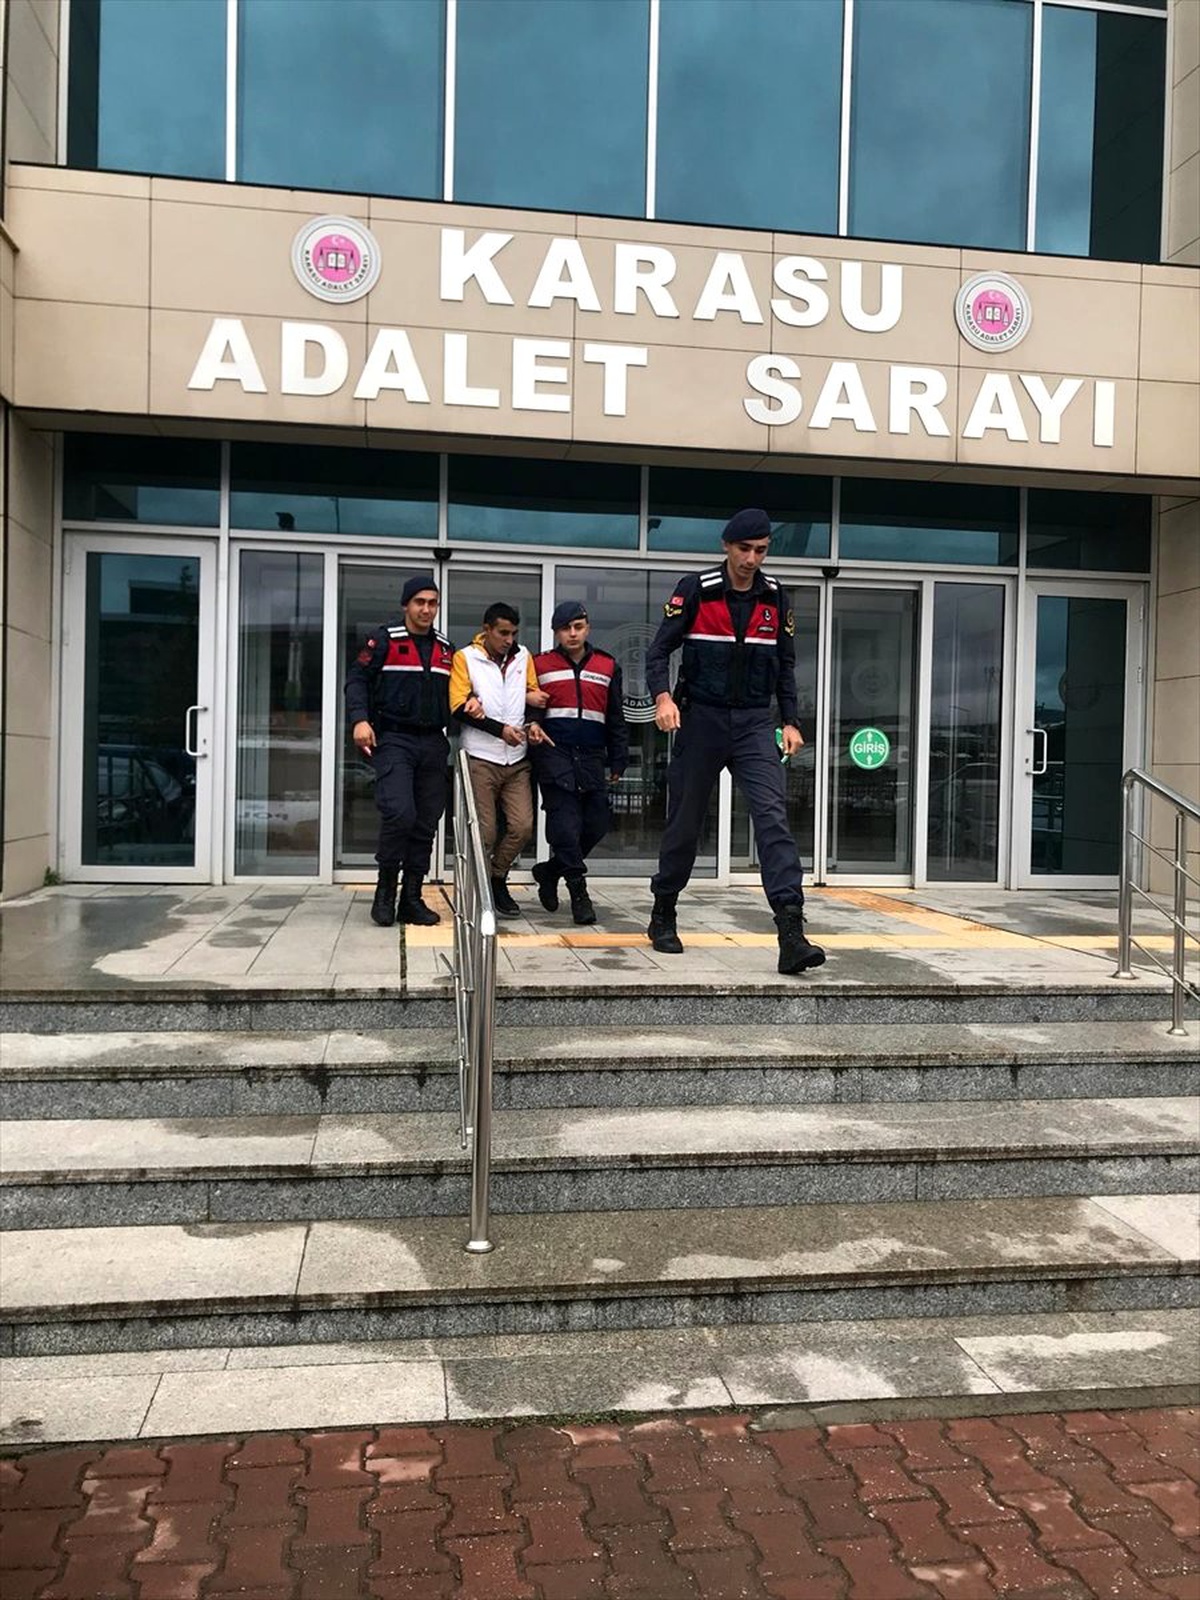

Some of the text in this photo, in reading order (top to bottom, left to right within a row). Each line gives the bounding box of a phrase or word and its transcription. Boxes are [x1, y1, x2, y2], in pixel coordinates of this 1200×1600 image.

[321, 281, 354, 290] ADALET
[440, 227, 905, 333] KARASU
[965, 304, 980, 335] KARASU
[980, 332, 1009, 342] ADALET
[1008, 307, 1020, 335] SARAYI
[188, 317, 1117, 448] ADALET SARAYI
[854, 740, 885, 756] GİRİŞ
